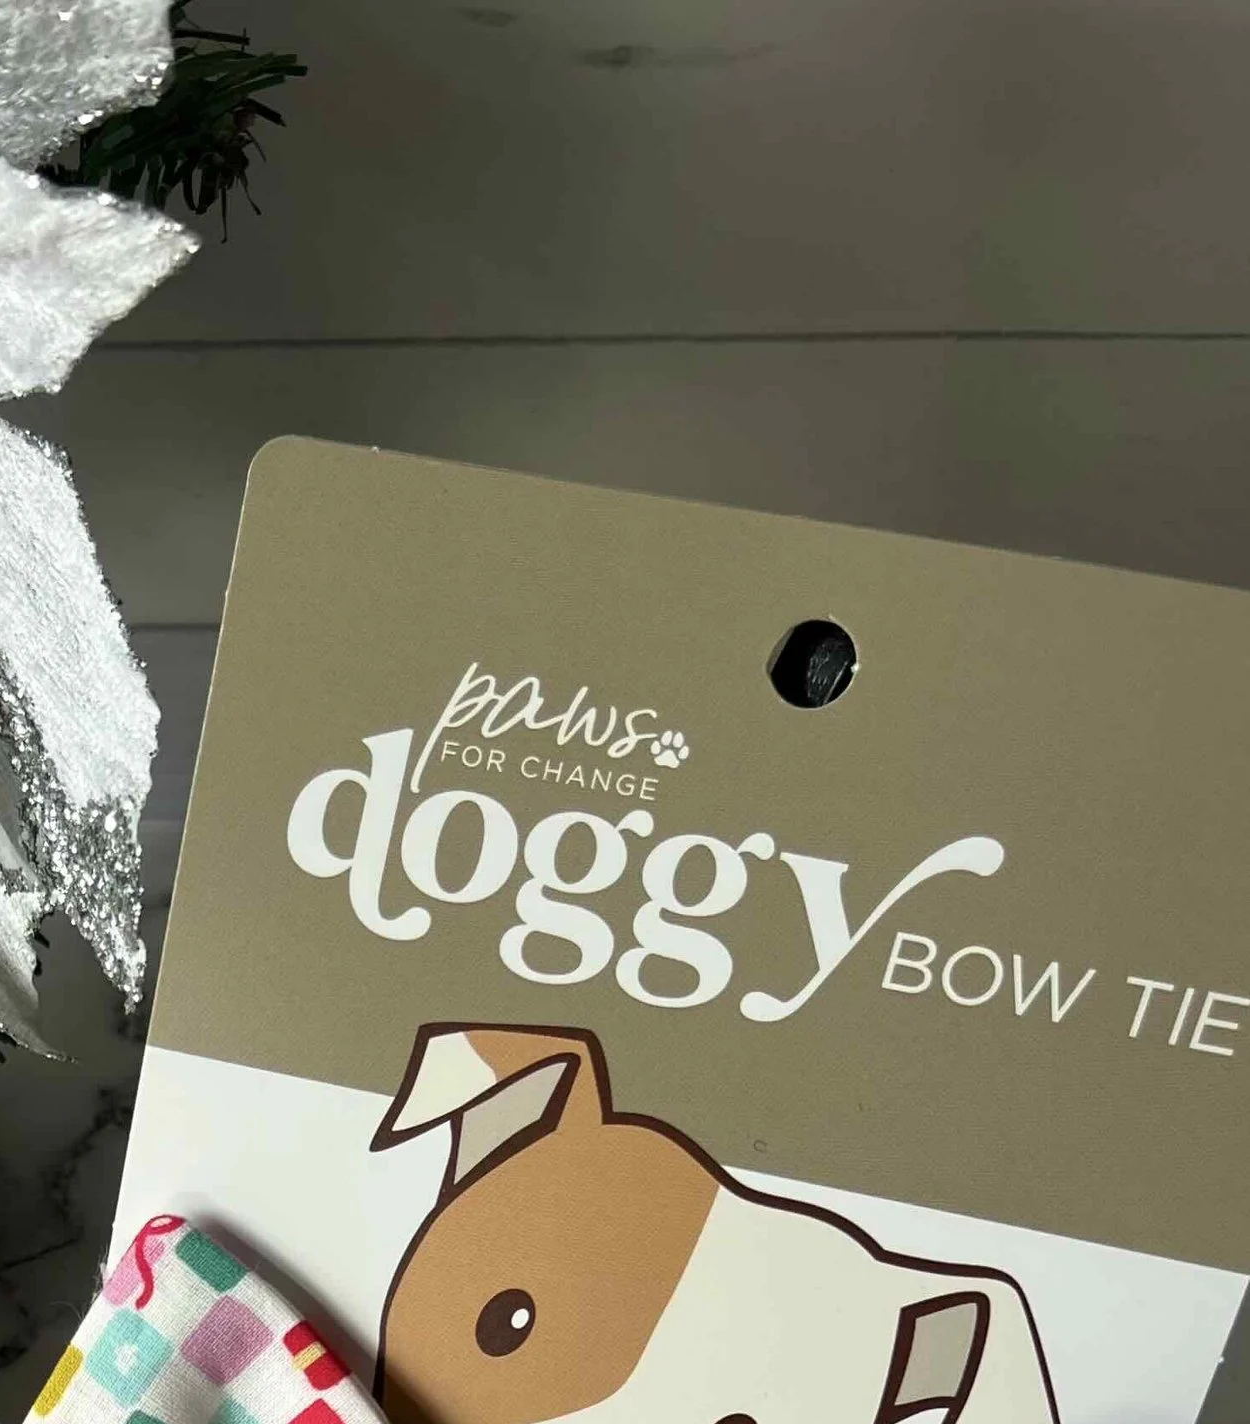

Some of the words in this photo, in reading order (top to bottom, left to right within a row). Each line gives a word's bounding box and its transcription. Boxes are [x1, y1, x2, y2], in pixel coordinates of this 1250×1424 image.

[410, 661, 659, 793] paws
[440, 741, 506, 774] FOR
[520, 755, 660, 801] CHANGE
[286, 728, 1005, 1022] doggy
[881, 930, 1097, 1025] BOW
[1126, 976, 1250, 1057] TIE
